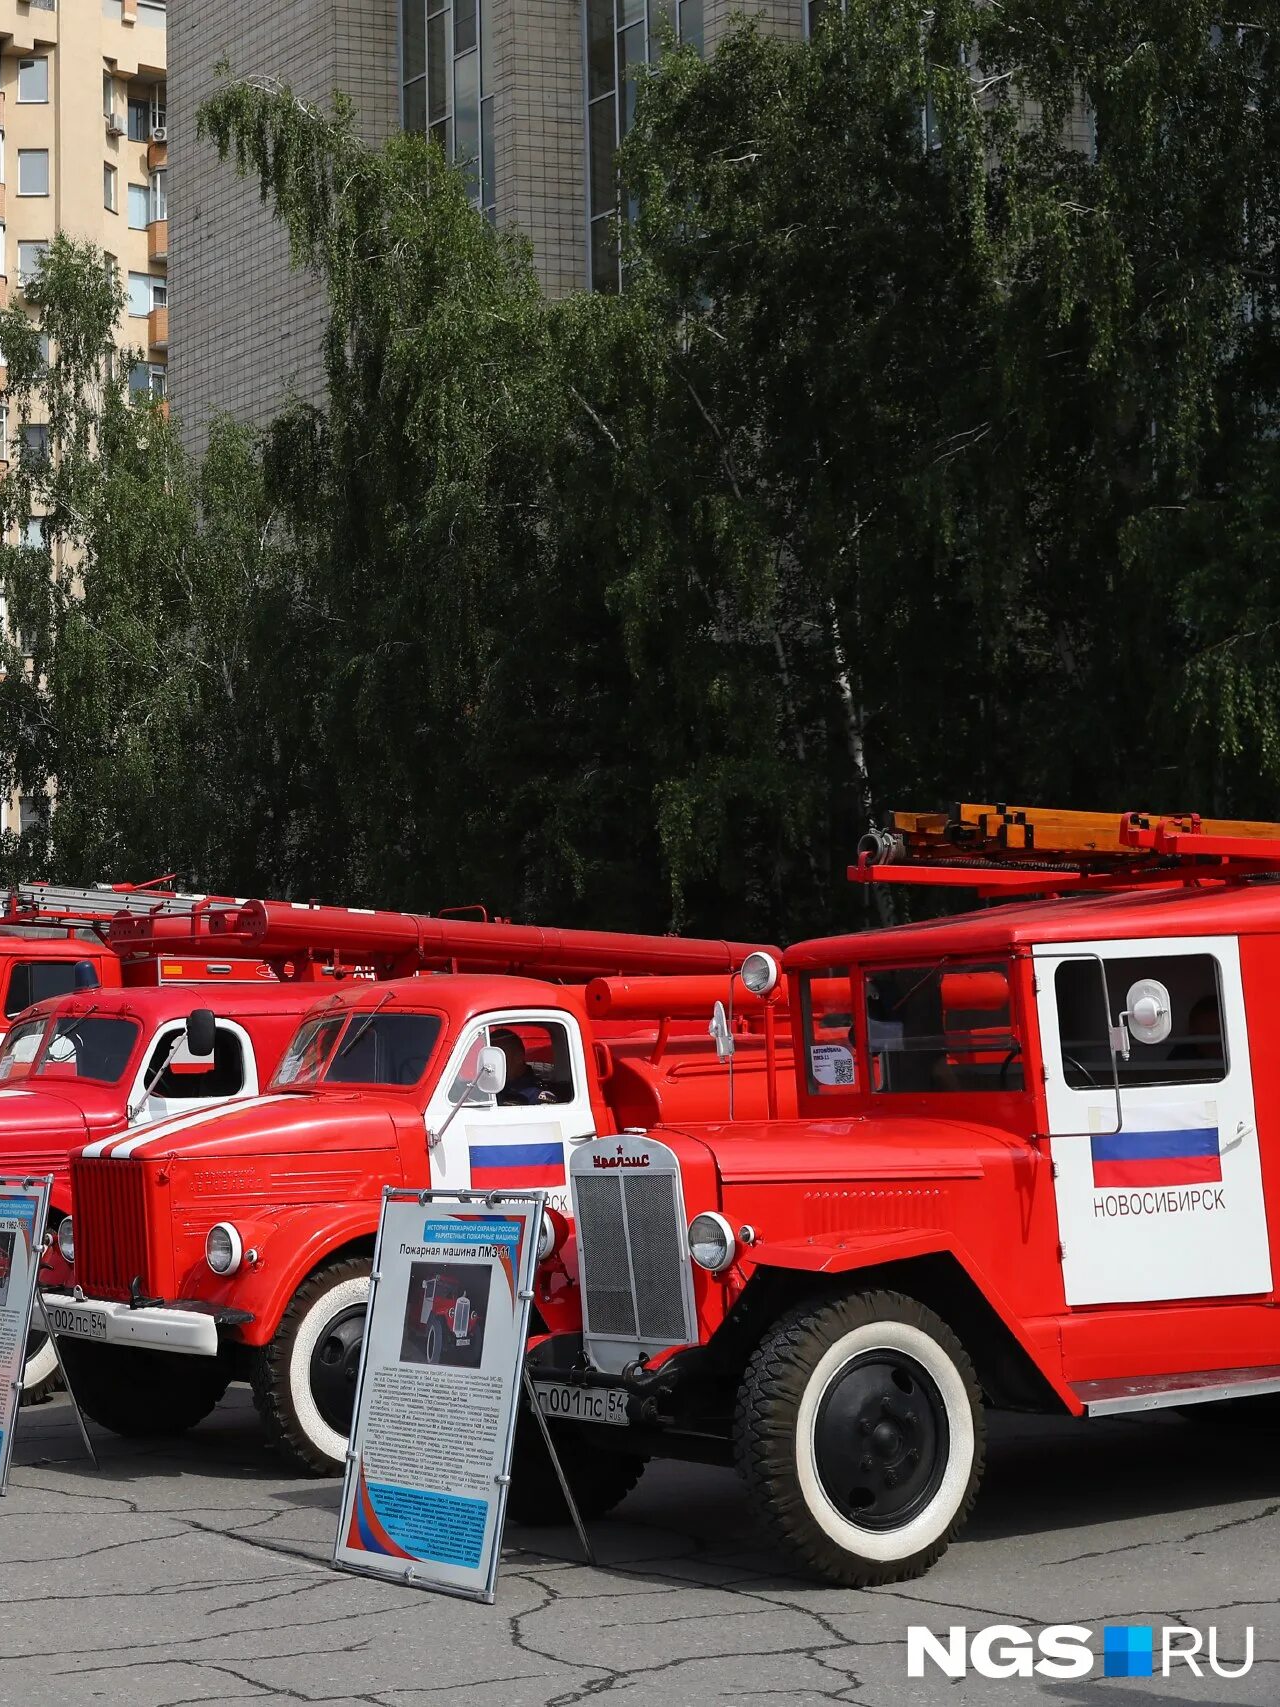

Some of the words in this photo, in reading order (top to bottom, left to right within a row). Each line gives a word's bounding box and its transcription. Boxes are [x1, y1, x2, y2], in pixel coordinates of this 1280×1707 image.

[1093, 1189, 1226, 1218] НОВОСИБИРСК
[400, 1244, 441, 1257] Пожарная
[442, 1247, 477, 1257] машина
[478, 1246, 510, 1258] ПМЗ-11
[91, 1314, 102, 1330] 54
[608, 1393, 624, 1413] 54
